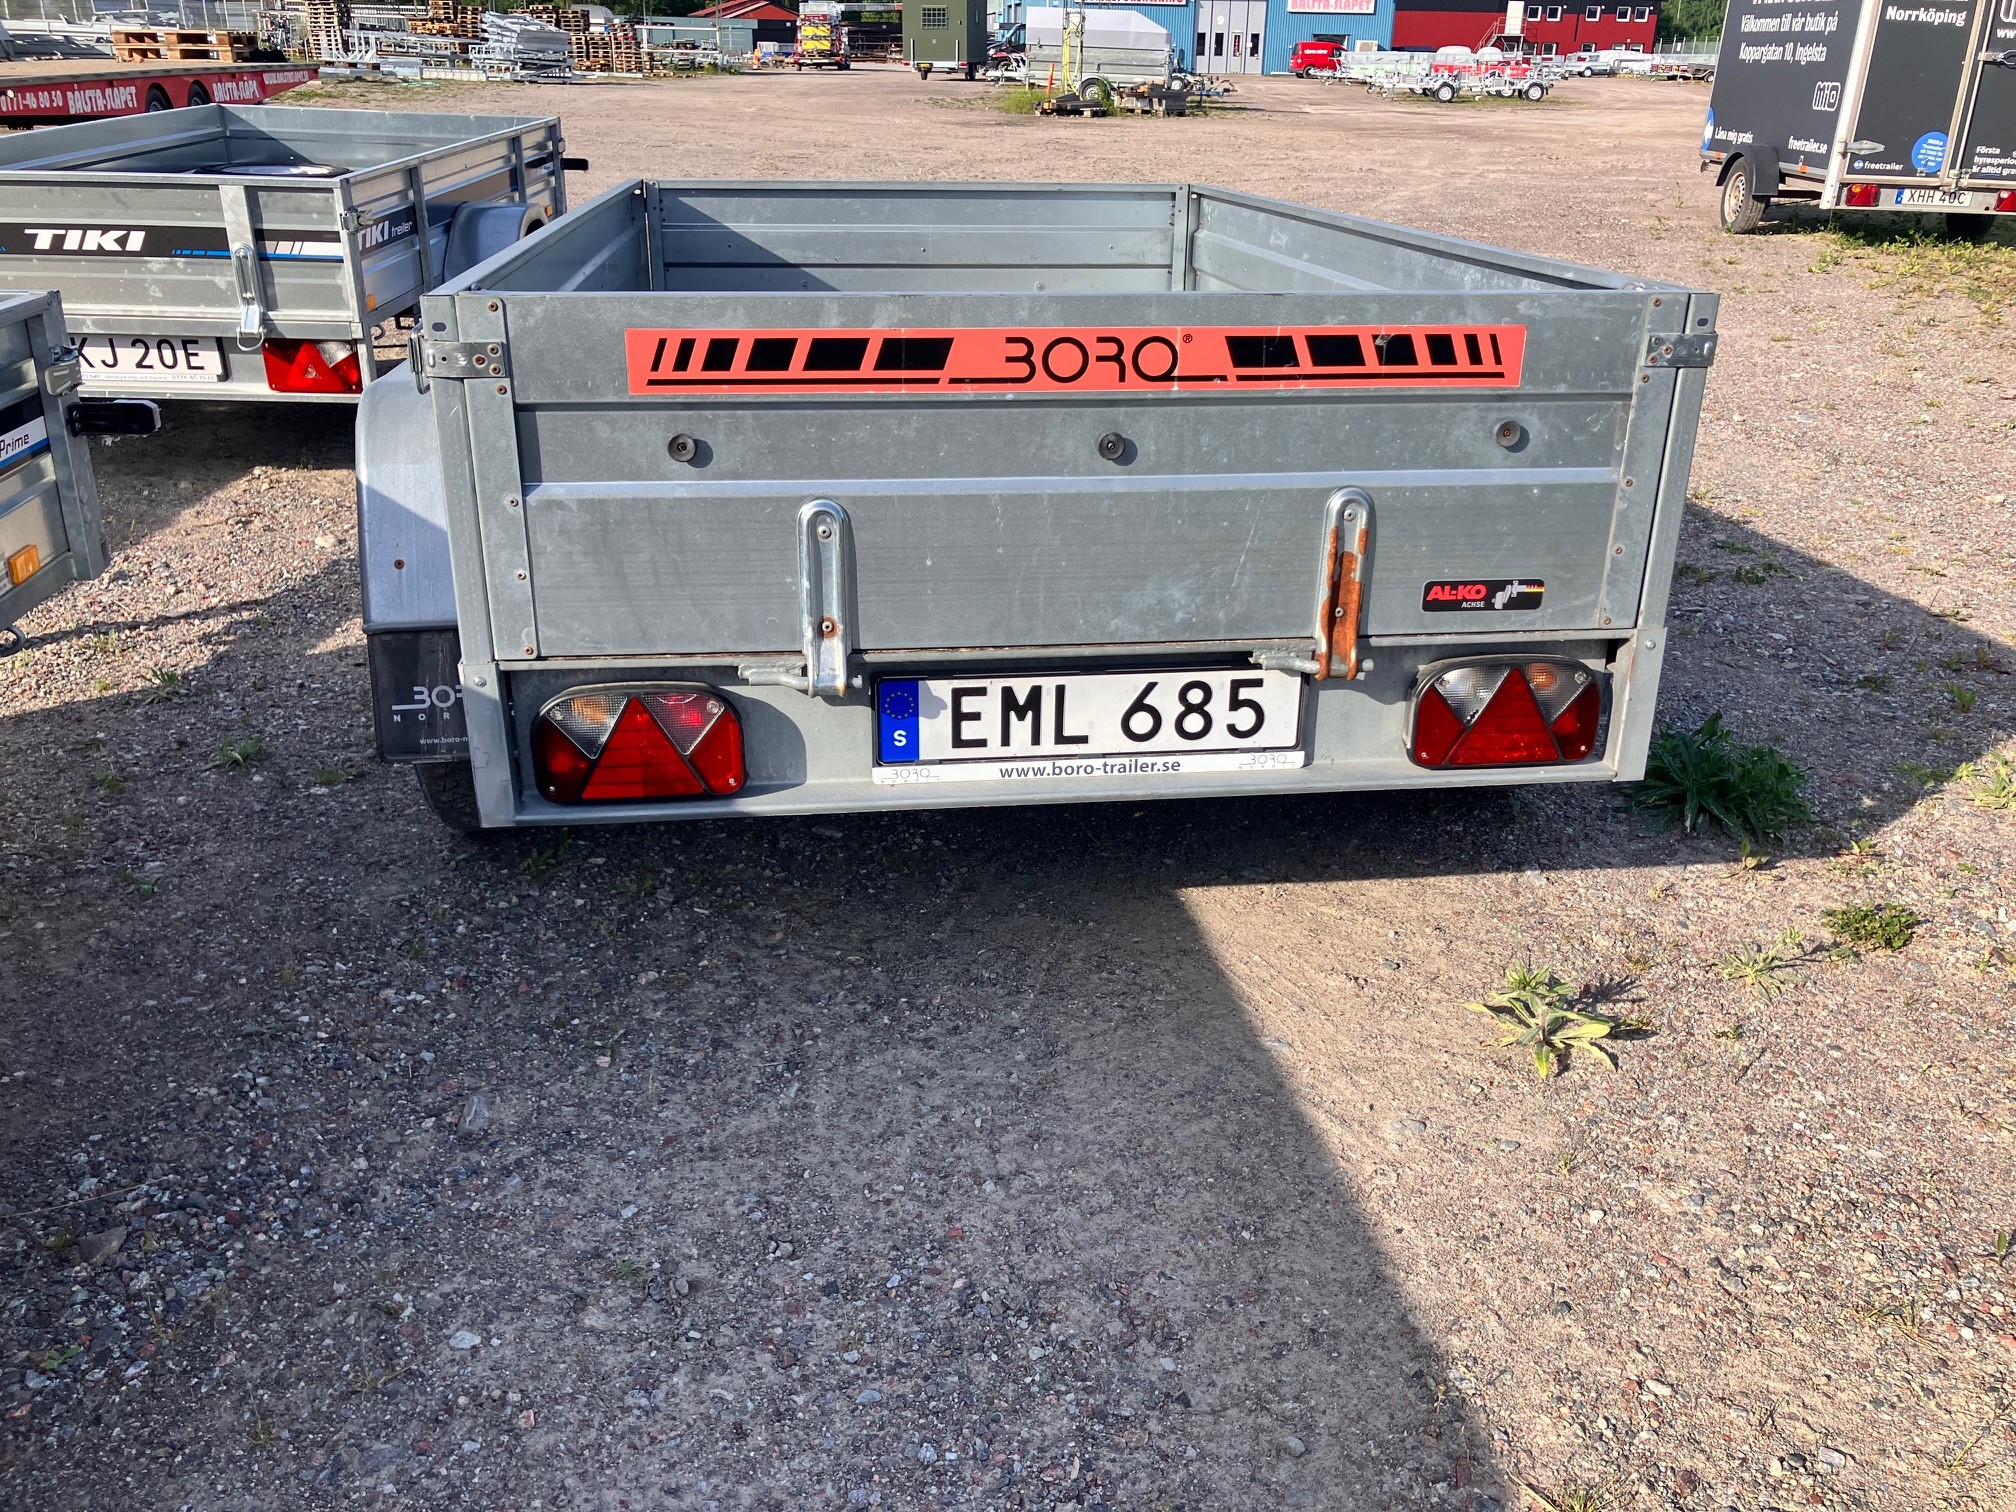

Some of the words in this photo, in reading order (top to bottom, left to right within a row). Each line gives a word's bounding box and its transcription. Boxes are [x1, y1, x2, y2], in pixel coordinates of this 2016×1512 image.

[1741, 15, 1780, 32] Välkommen
[1780, 13, 1793, 32] till
[1791, 12, 1806, 31] vår
[1805, 12, 1827, 31] butik
[1825, 10, 1839, 35] på
[1885, 6, 1967, 27] Norrköping
[1739, 42, 1784, 64] Koppargatan
[1795, 42, 1827, 65] Ingelsta
[1714, 126, 1727, 140] Låna
[1726, 129, 1738, 145] mig
[1738, 131, 1754, 145] gratis
[1976, 145, 2001, 154] Första
[1864, 161, 1904, 171] freetrailer
[1974, 155, 2016, 166] hyresperio
[1981, 166, 2002, 174] alltid
[1908, 189, 1936, 204] XHH
[24, 229, 146, 252] TIKI
[357, 220, 390, 251] TIKI
[391, 221, 413, 238] trailer
[69, 337, 119, 369] KJ
[130, 338, 206, 371] 20E
[0, 433, 30, 458] Prime
[1426, 584, 1488, 601] AL-KO
[951, 683, 1089, 749] EML
[1120, 678, 1266, 744] 685
[419, 736, 468, 745] www.boro-n
[893, 730, 907, 747] S
[999, 758, 1181, 779] www.boro-trailer.se
